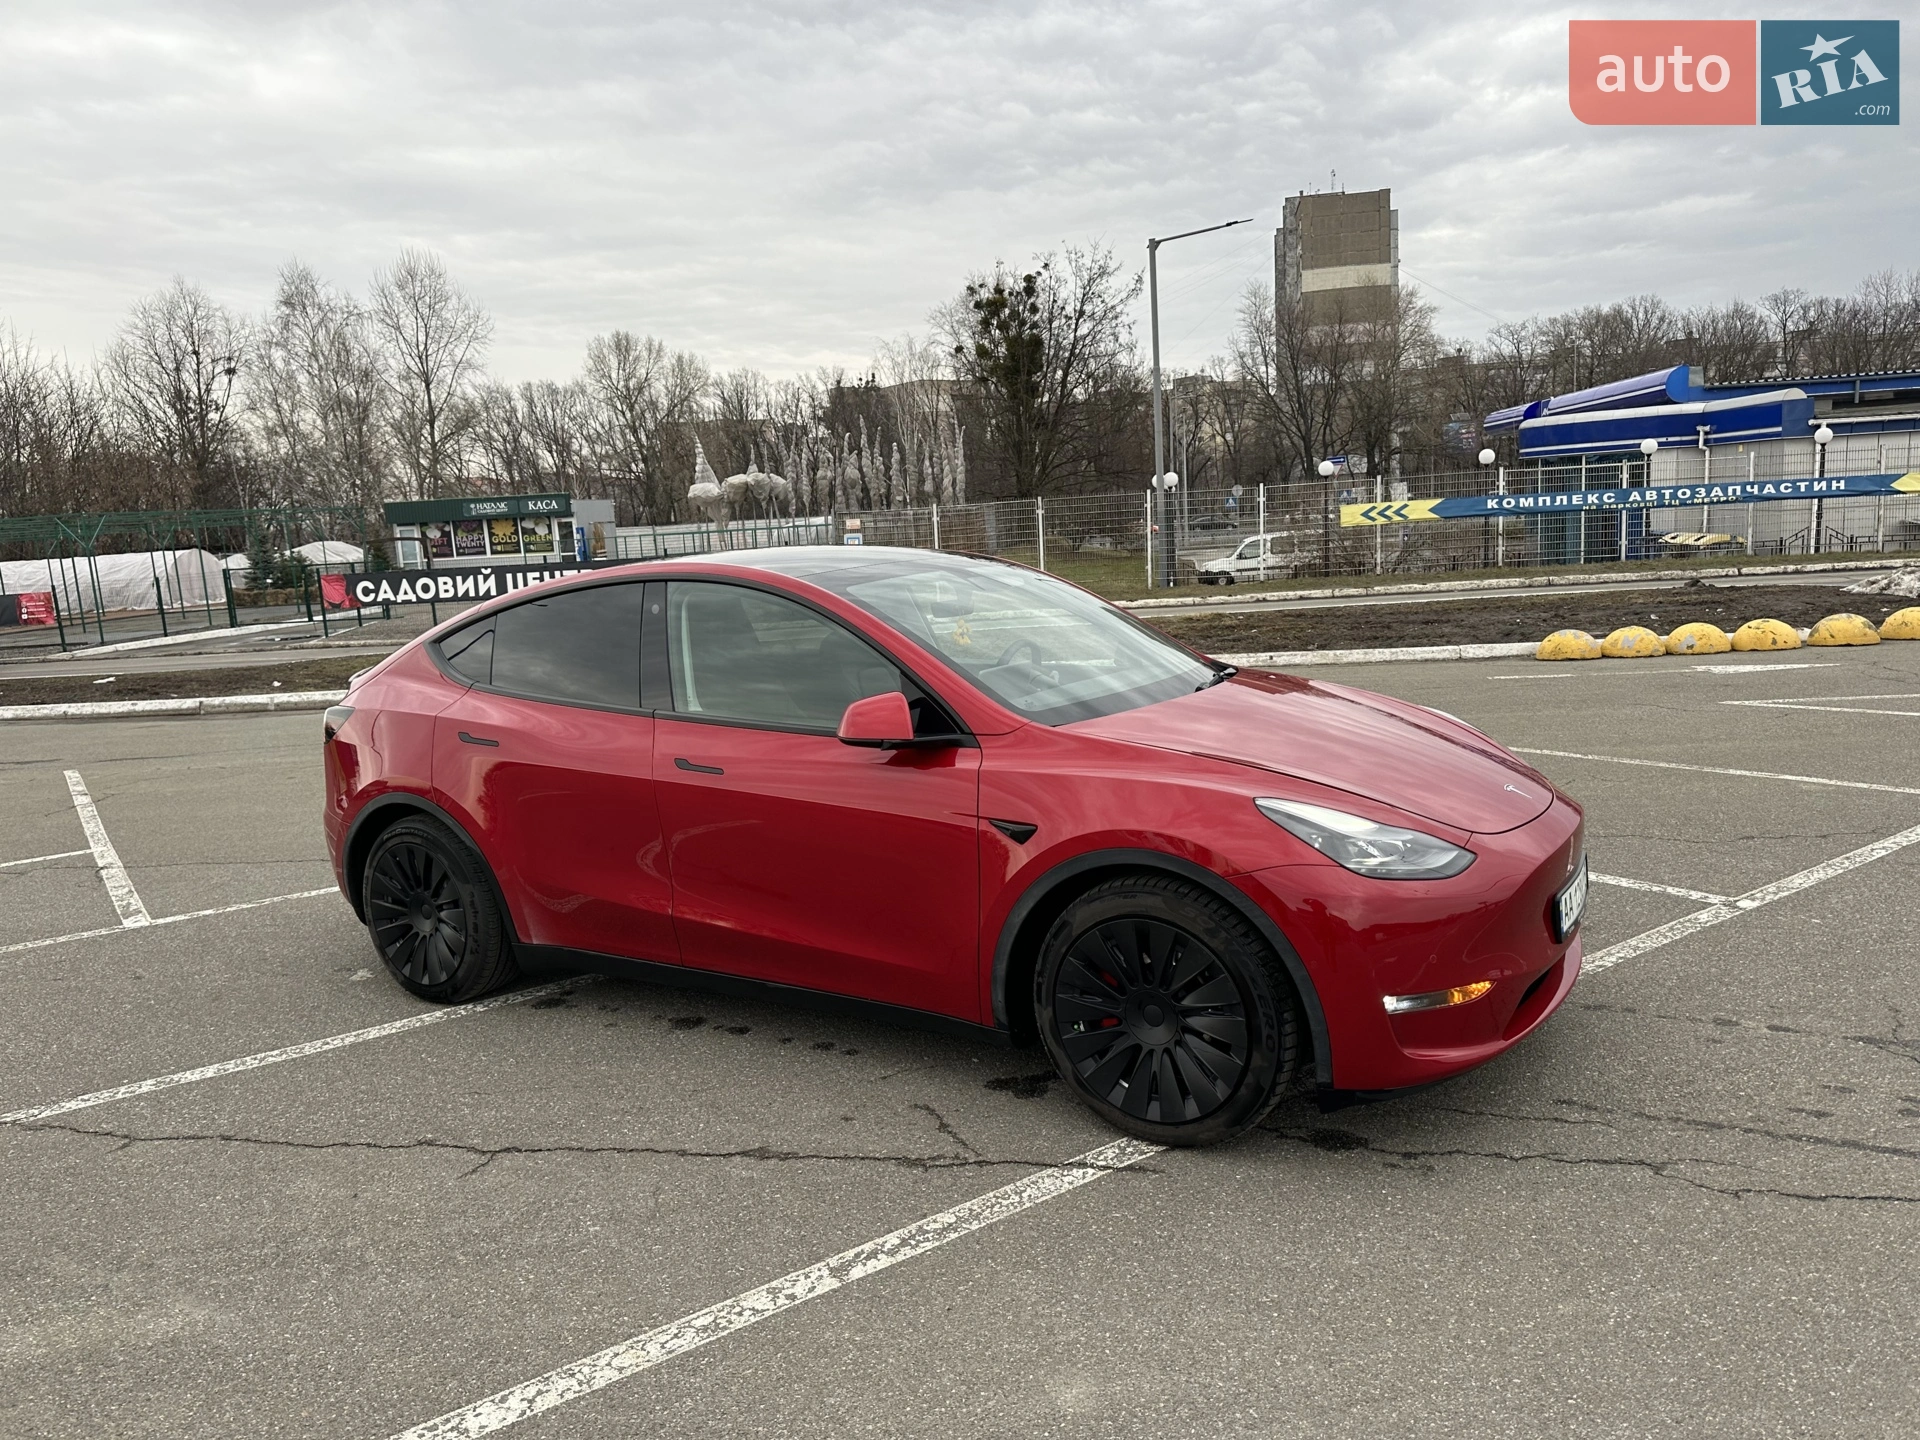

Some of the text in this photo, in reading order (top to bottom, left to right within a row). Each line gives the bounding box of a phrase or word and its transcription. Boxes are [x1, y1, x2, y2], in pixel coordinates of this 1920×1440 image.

[1486, 479, 1845, 509] КОМПЛЕКС АВТОЗАПЧАСТИН
[528, 500, 558, 510] КАСА
[456, 534, 484, 543] HAPPY
[492, 535, 518, 543] GOLD
[523, 534, 552, 542] GREEN
[456, 540, 485, 548] TWENTY
[355, 568, 497, 603] САДОВИЙ
